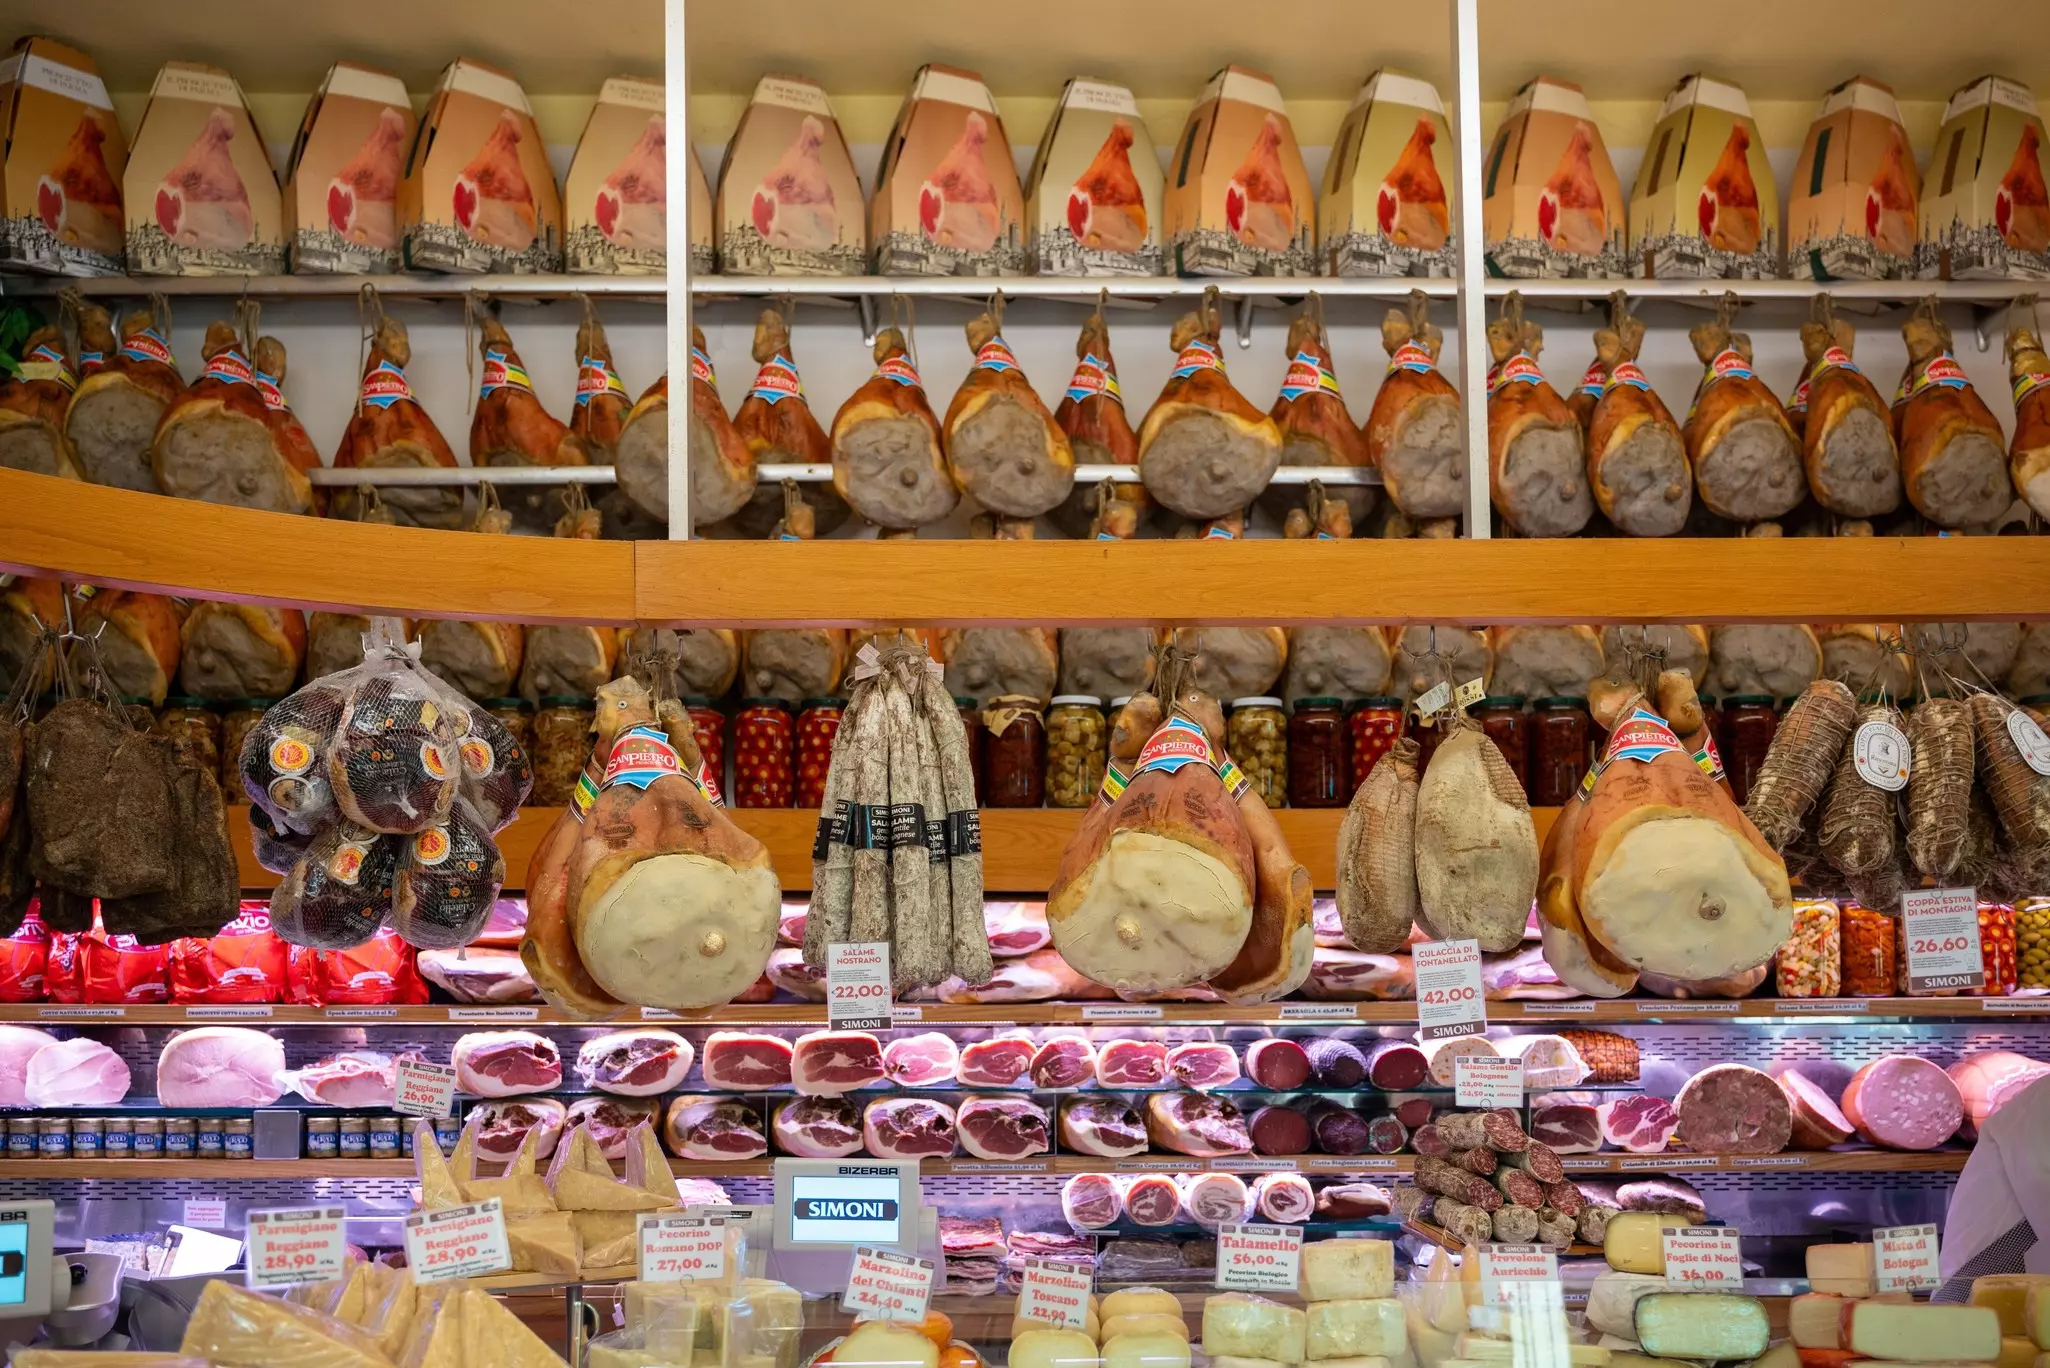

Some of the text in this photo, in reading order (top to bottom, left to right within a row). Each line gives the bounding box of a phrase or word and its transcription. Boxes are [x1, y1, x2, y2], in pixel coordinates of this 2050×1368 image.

[1611, 732, 1677, 752] SANPIETRO
[1859, 730, 1869, 751] COPPA
[1142, 741, 1206, 761] SANPIETRO
[608, 752, 675, 772] SANPIETRO
[1907, 895, 1972, 907] COPPA ESTIVA
[1907, 905, 1973, 917] DI MONTAGNA
[842, 948, 875, 956] SALAME
[1418, 947, 1462, 958] CULACCIA
[836, 957, 882, 965] NOSTRANO
[1416, 954, 1479, 968] FONTANELLATO
[1924, 975, 1971, 988] SIMONI
[841, 1019, 881, 1029] SIMONI
[1433, 1023, 1475, 1038] SIMONI
[402, 1069, 451, 1084] Parmigiano
[1470, 1072, 1509, 1080] Bolognese
[405, 1080, 444, 1095] Reggiano
[403, 1091, 435, 1103] 26,90
[838, 1166, 898, 1176] BIZERBA
[437, 1208, 468, 1221] SIMONI
[808, 1201, 884, 1218] SIMONI
[257, 1222, 337, 1236] Parmigiano
[414, 1215, 494, 1237] Parmigiano
[671, 1219, 698, 1227] SIMONI
[658, 1229, 711, 1239] Pecorino
[1247, 1227, 1274, 1235] SIMONI
[265, 1240, 329, 1253] Reggiano
[425, 1232, 488, 1250] Reggiano
[646, 1241, 723, 1254] Romano DOP
[1222, 1235, 1299, 1252] Talamello
[1670, 1240, 1732, 1249] Pecorino in
[1882, 1239, 1927, 1253] Misto di
[265, 1253, 316, 1270] 28,90
[425, 1246, 477, 1265] 28,90
[883, 1253, 909, 1264] SIMONI
[1232, 1253, 1275, 1267] 56,00
[1489, 1253, 1547, 1263] Provolone
[1666, 1253, 1739, 1264] Foglie di Noci
[656, 1258, 703, 1273] 27,00
[859, 1258, 927, 1281] Marzolino
[1047, 1263, 1070, 1272] SIMONI
[1883, 1258, 1929, 1270] Bologna
[1228, 1268, 1288, 1278] Pecorino Biologico
[1491, 1267, 1548, 1276] Auricchio
[1027, 1271, 1087, 1290] Marzolino
[852, 1275, 926, 1300] del Chianti
[858, 1291, 903, 1309] 24,40
[1032, 1288, 1079, 1306] Toscano
[1032, 1306, 1067, 1321] 22,90
